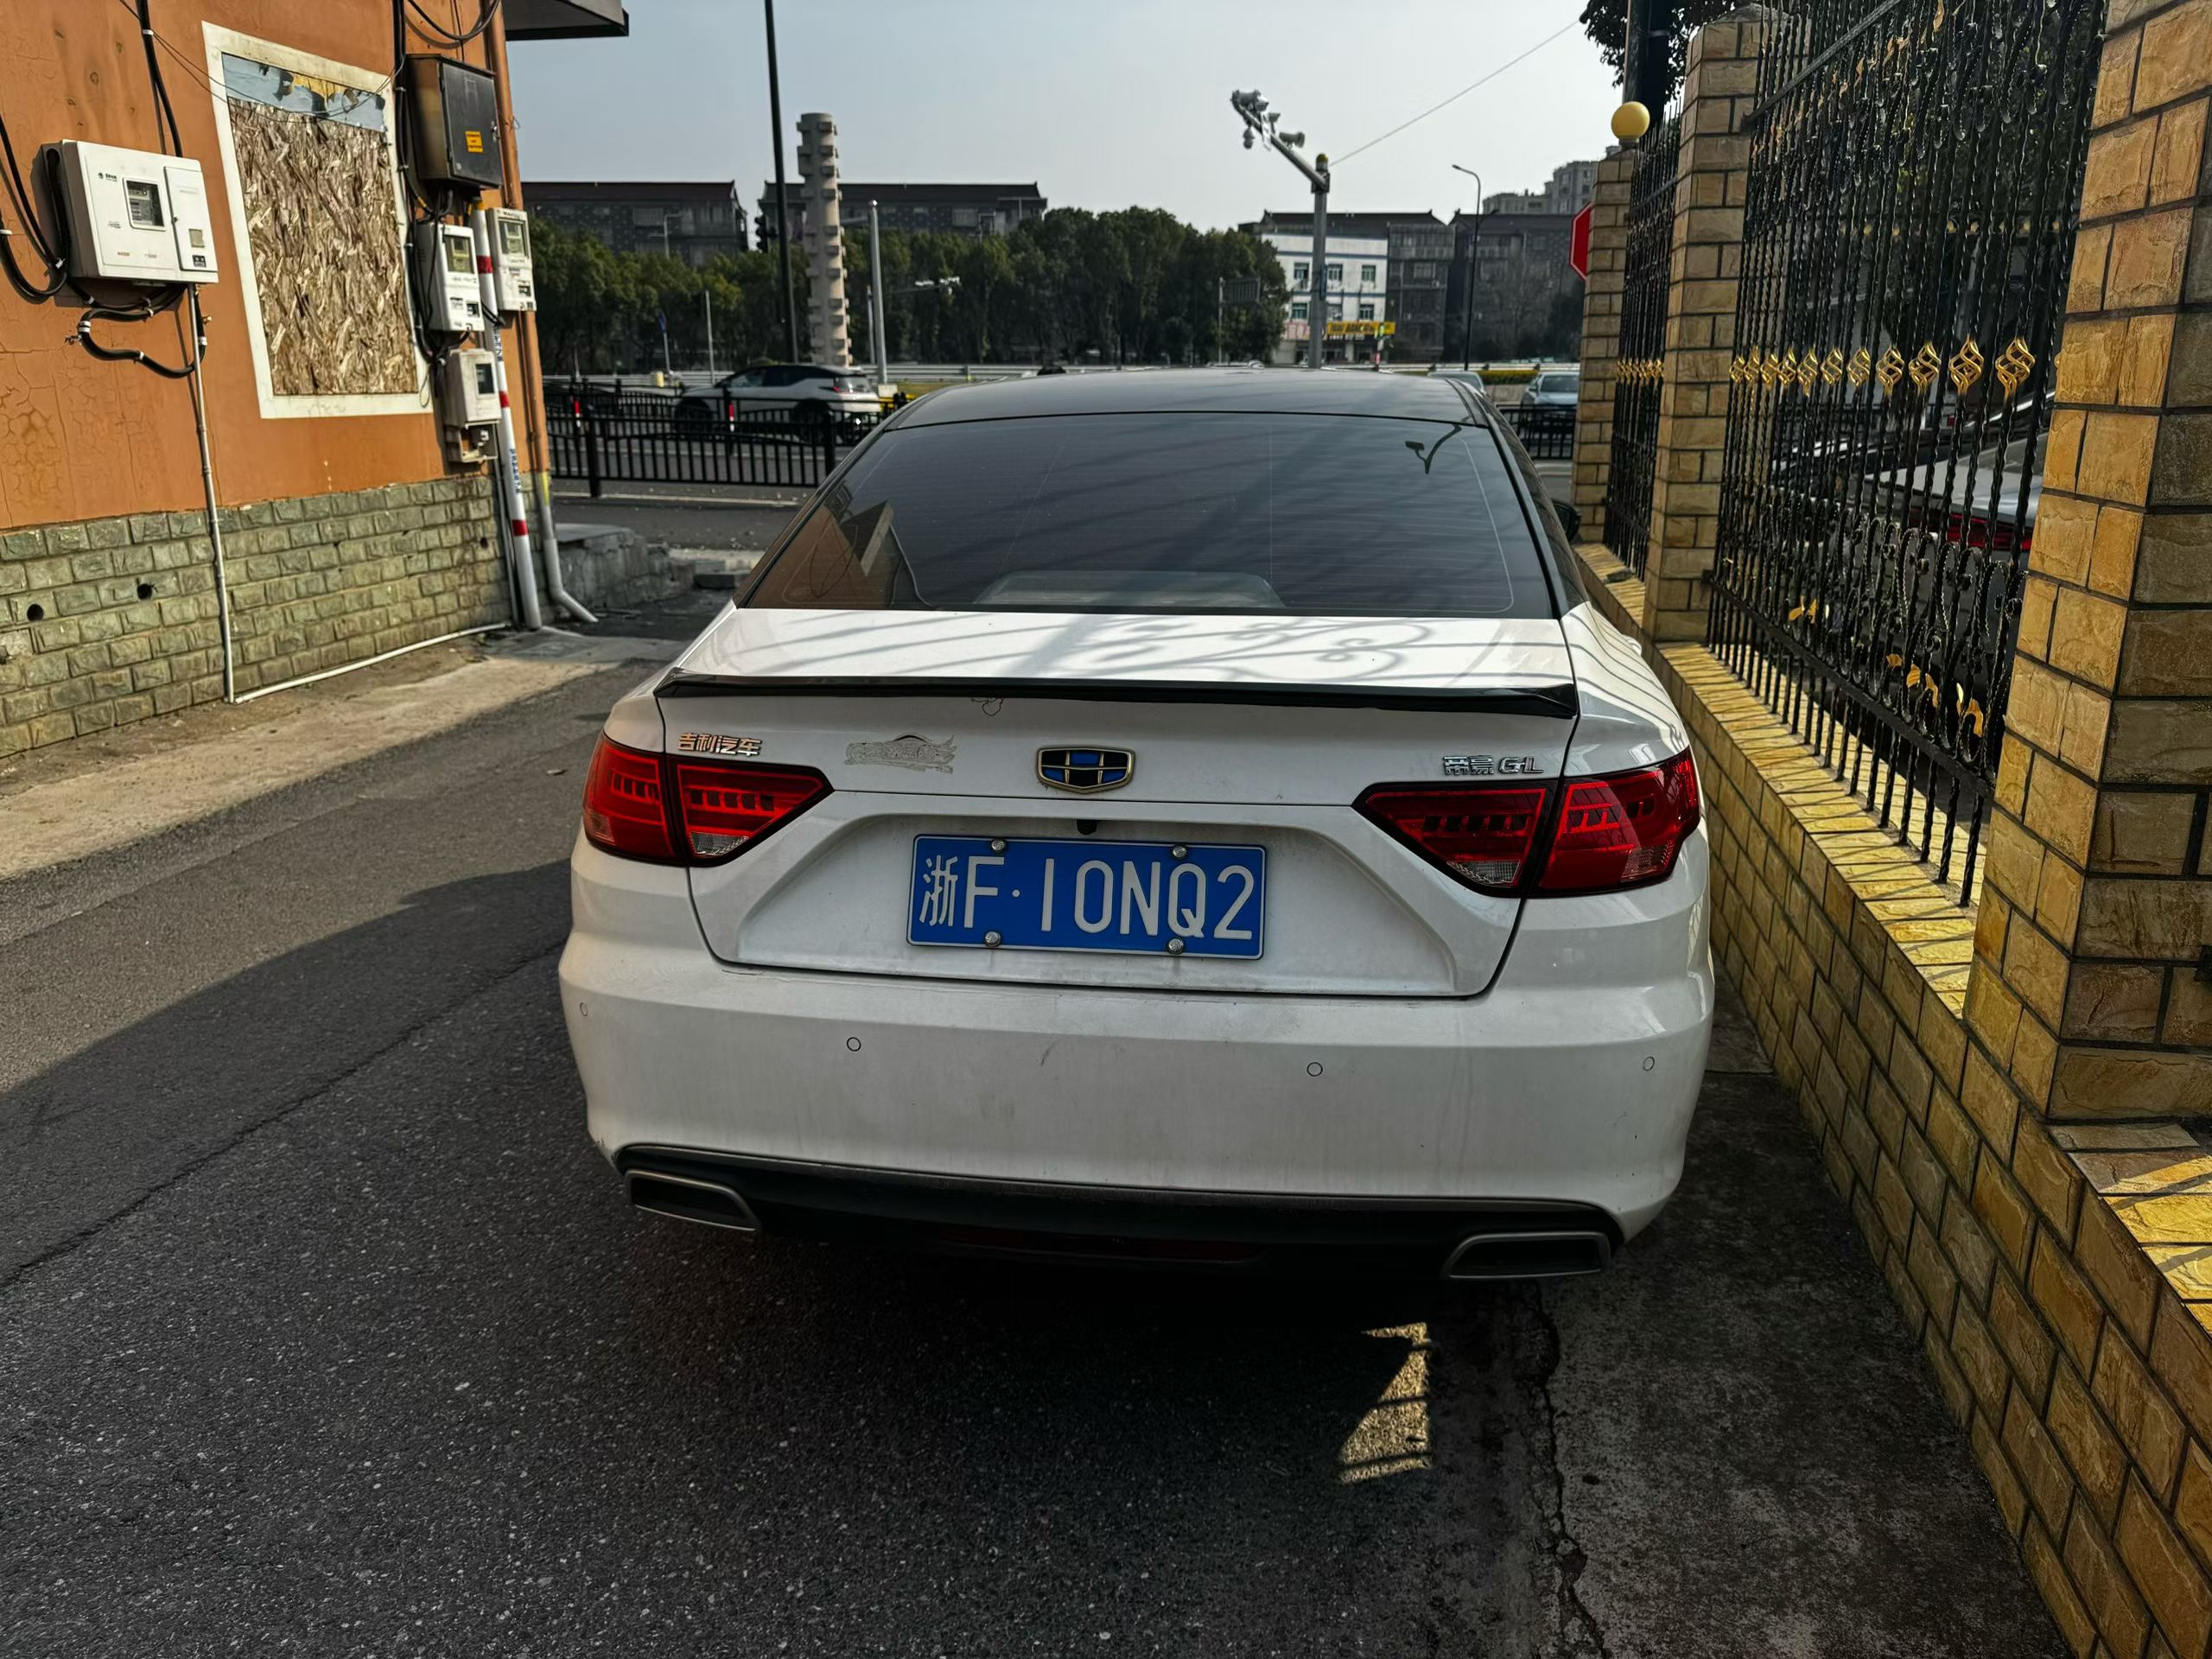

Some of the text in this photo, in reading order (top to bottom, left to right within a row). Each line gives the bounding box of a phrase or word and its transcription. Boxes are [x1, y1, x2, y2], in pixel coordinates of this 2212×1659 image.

[677, 733, 761, 756] 吉利汽车
[1443, 754, 1544, 776] 帝豪 GL
